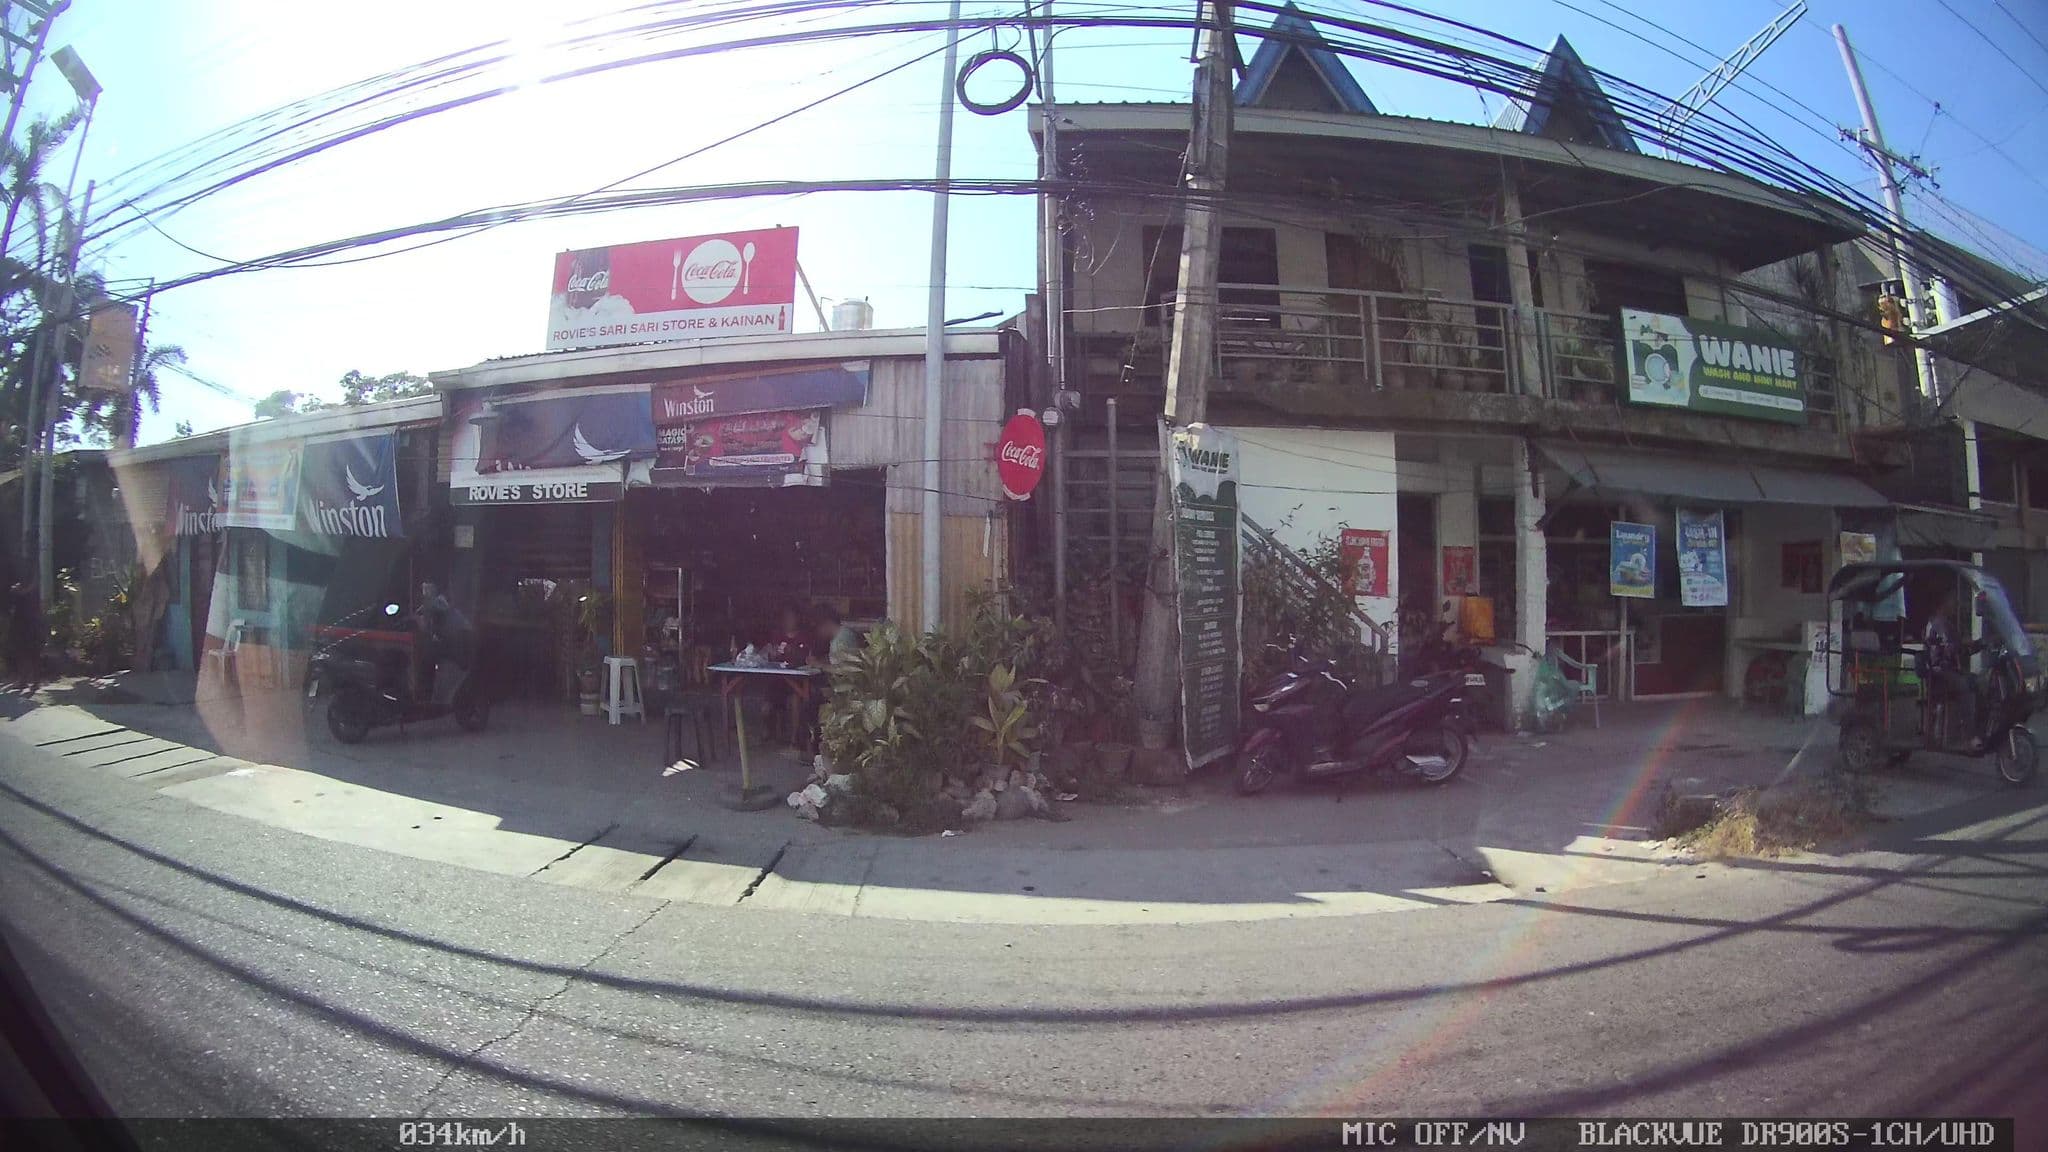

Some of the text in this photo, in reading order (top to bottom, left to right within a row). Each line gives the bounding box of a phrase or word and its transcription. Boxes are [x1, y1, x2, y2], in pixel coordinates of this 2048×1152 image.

[553, 314, 776, 341] ROVIE'S SARI SARI STORE & KAINAN
[1698, 334, 1797, 379] WANIE
[664, 398, 715, 419] Winston
[532, 481, 588, 500] STORE
[303, 497, 388, 539] Winston
